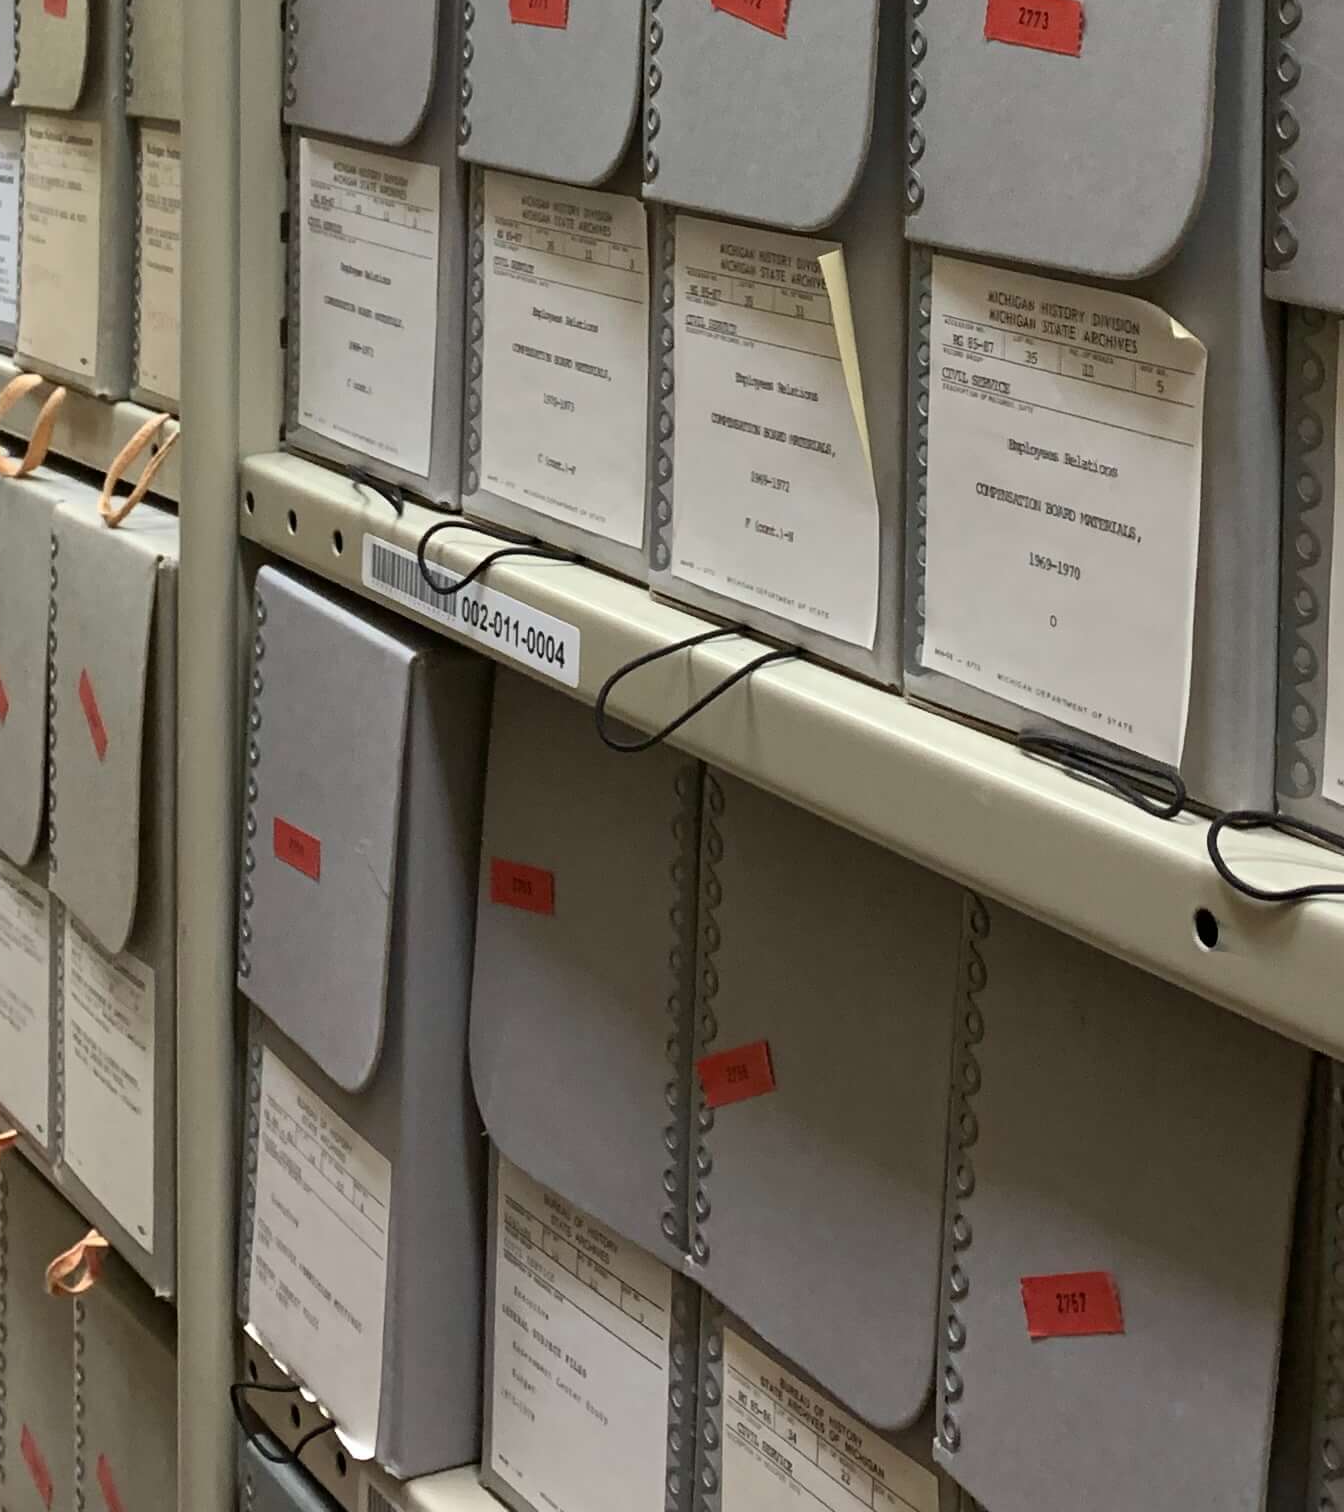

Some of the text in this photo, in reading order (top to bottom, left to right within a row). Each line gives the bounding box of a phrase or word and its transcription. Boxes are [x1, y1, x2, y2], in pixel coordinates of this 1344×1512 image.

[1018, 7, 1049, 30] 2773
[988, 291, 1140, 336] MICHIGAN HISTORY DIVISION
[989, 309, 1139, 354] MICHIGAN STATE ARCHIVES
[942, 367, 1011, 395] CIVIL SERVICE
[1157, 380, 1165, 394] 5
[1063, 453, 1119, 478] Relations
[976, 482, 1142, 544] COMPENSATION BOARD MATERIALS,
[1029, 552, 1081, 581] 1969-1970
[462, 596, 565, 669] 002-011-0004
[1054, 1292, 1087, 1314] 2757
